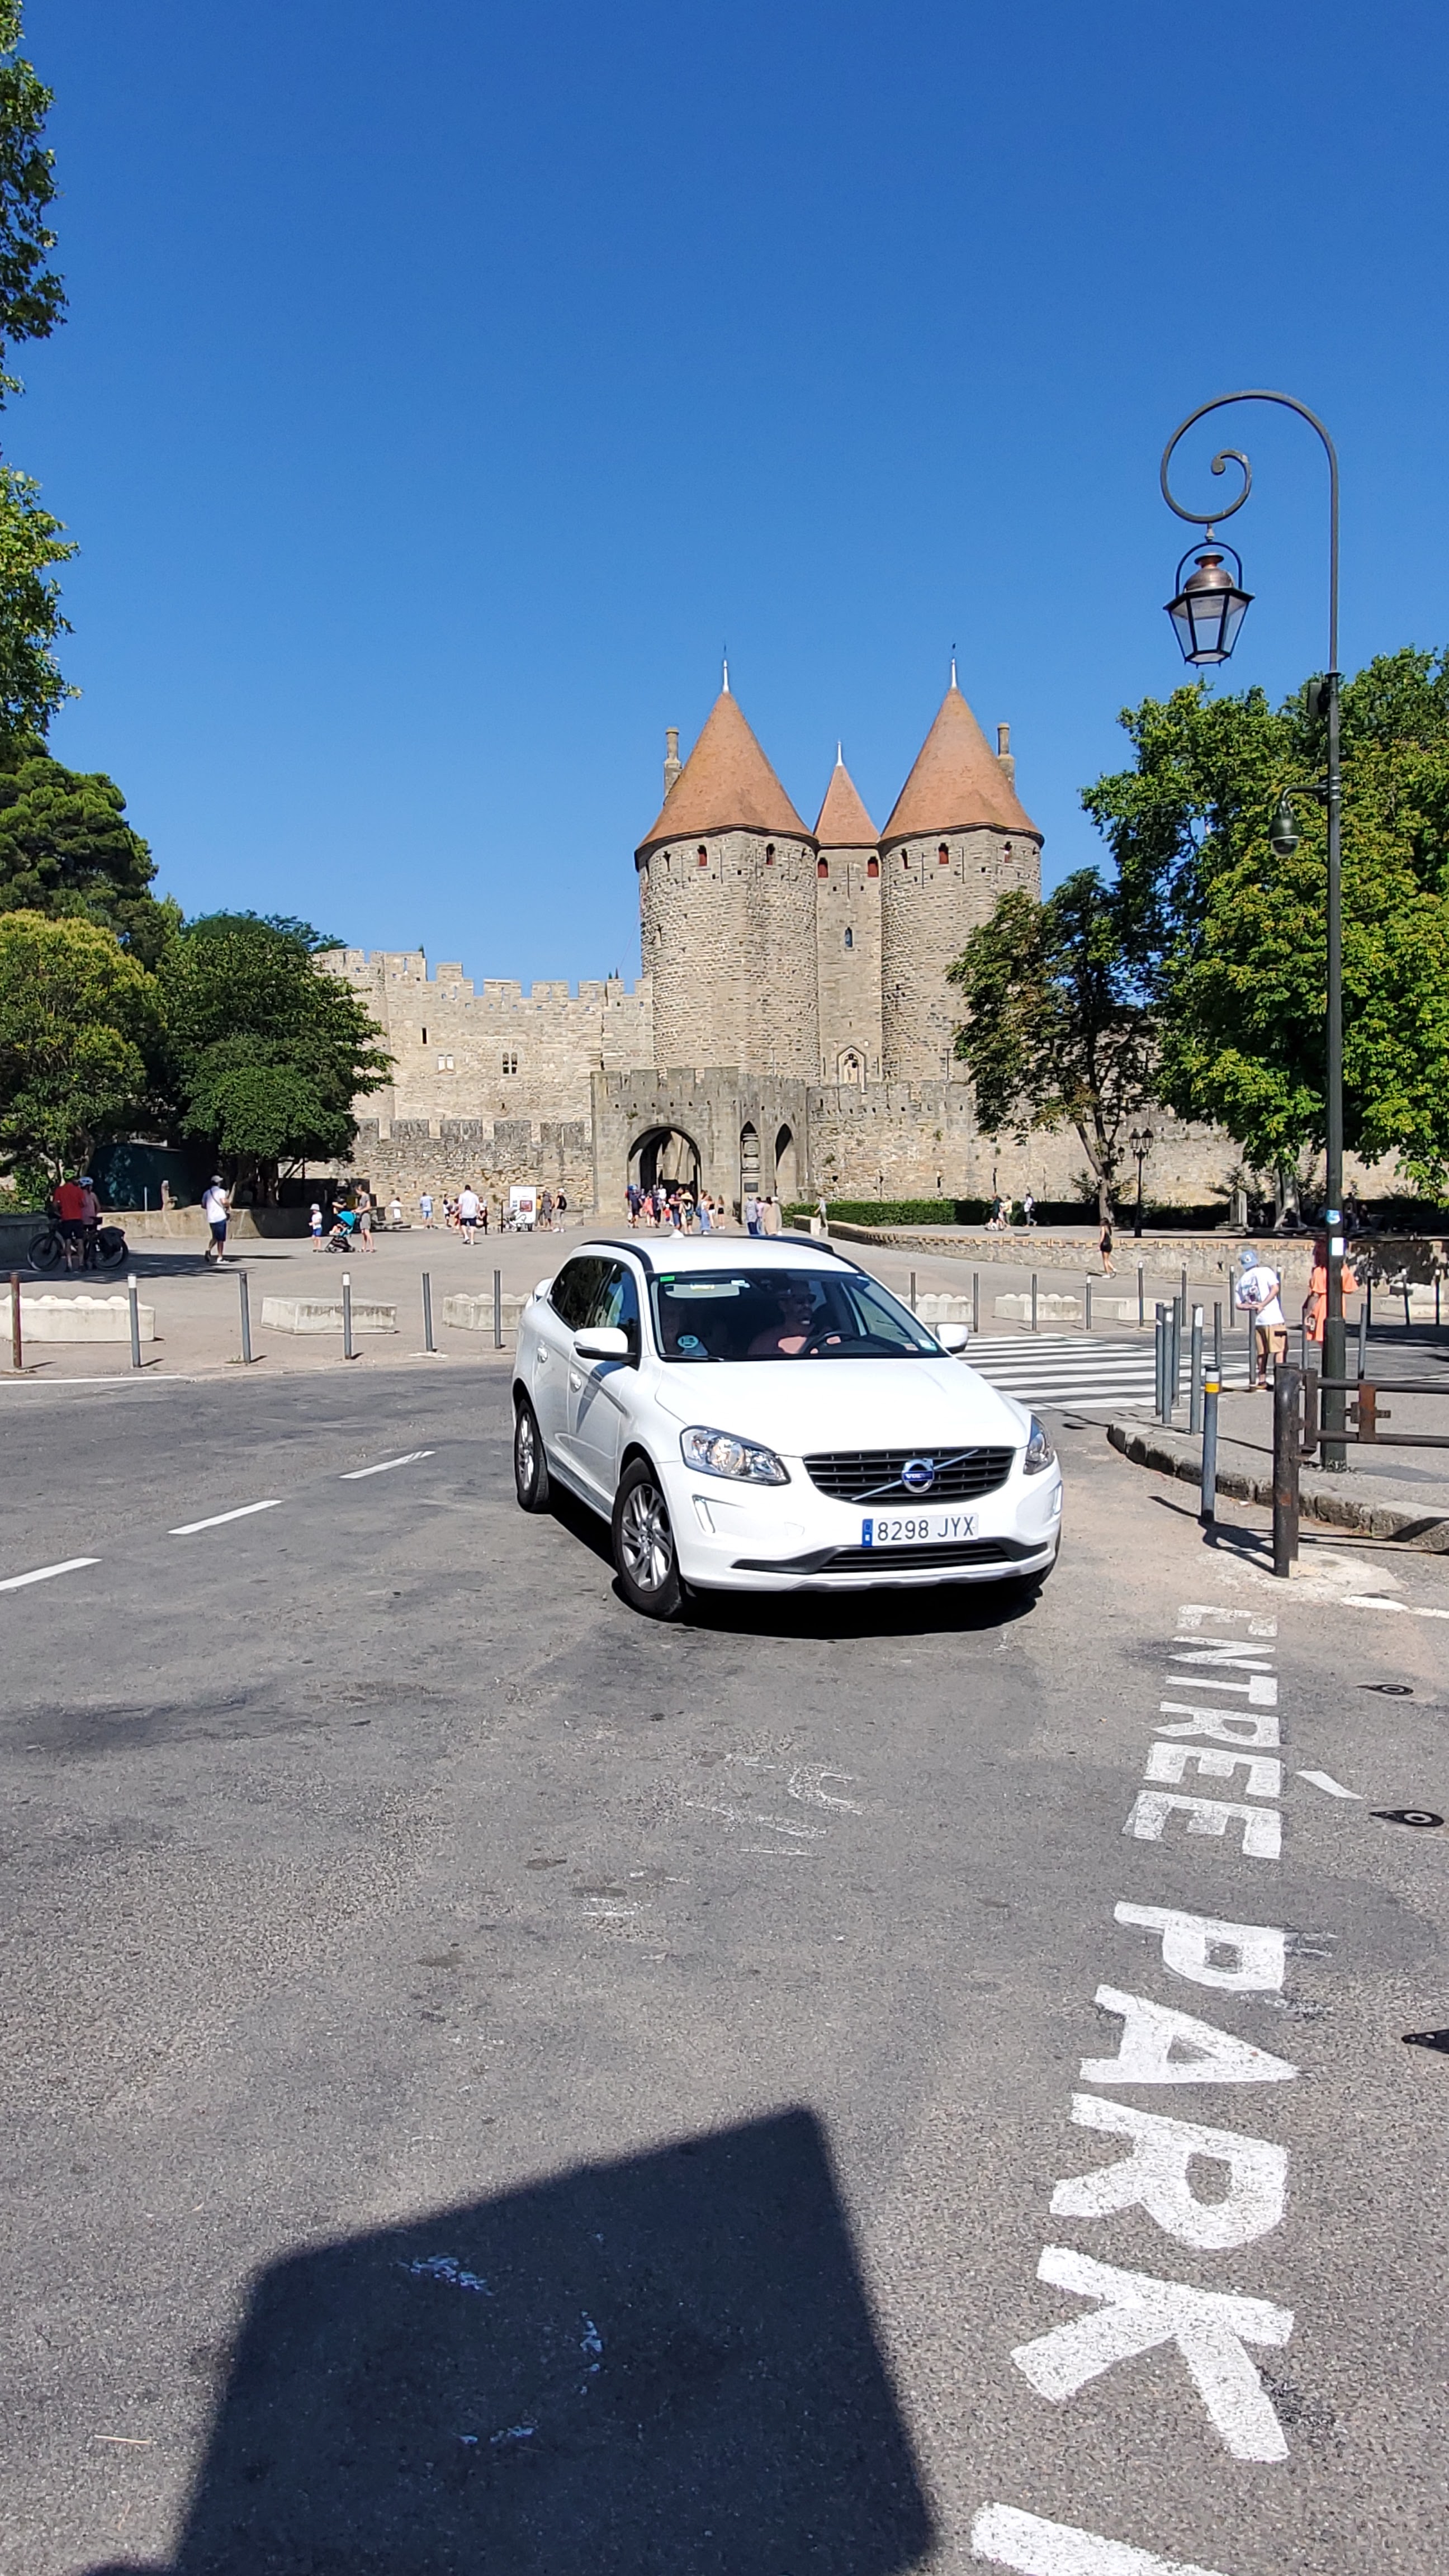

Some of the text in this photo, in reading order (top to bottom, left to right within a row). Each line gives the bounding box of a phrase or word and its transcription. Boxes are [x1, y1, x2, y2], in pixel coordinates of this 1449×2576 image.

[877, 1516, 974, 1541] 8298 JYX
[1120, 1603, 1364, 1860] ENTRÉE
